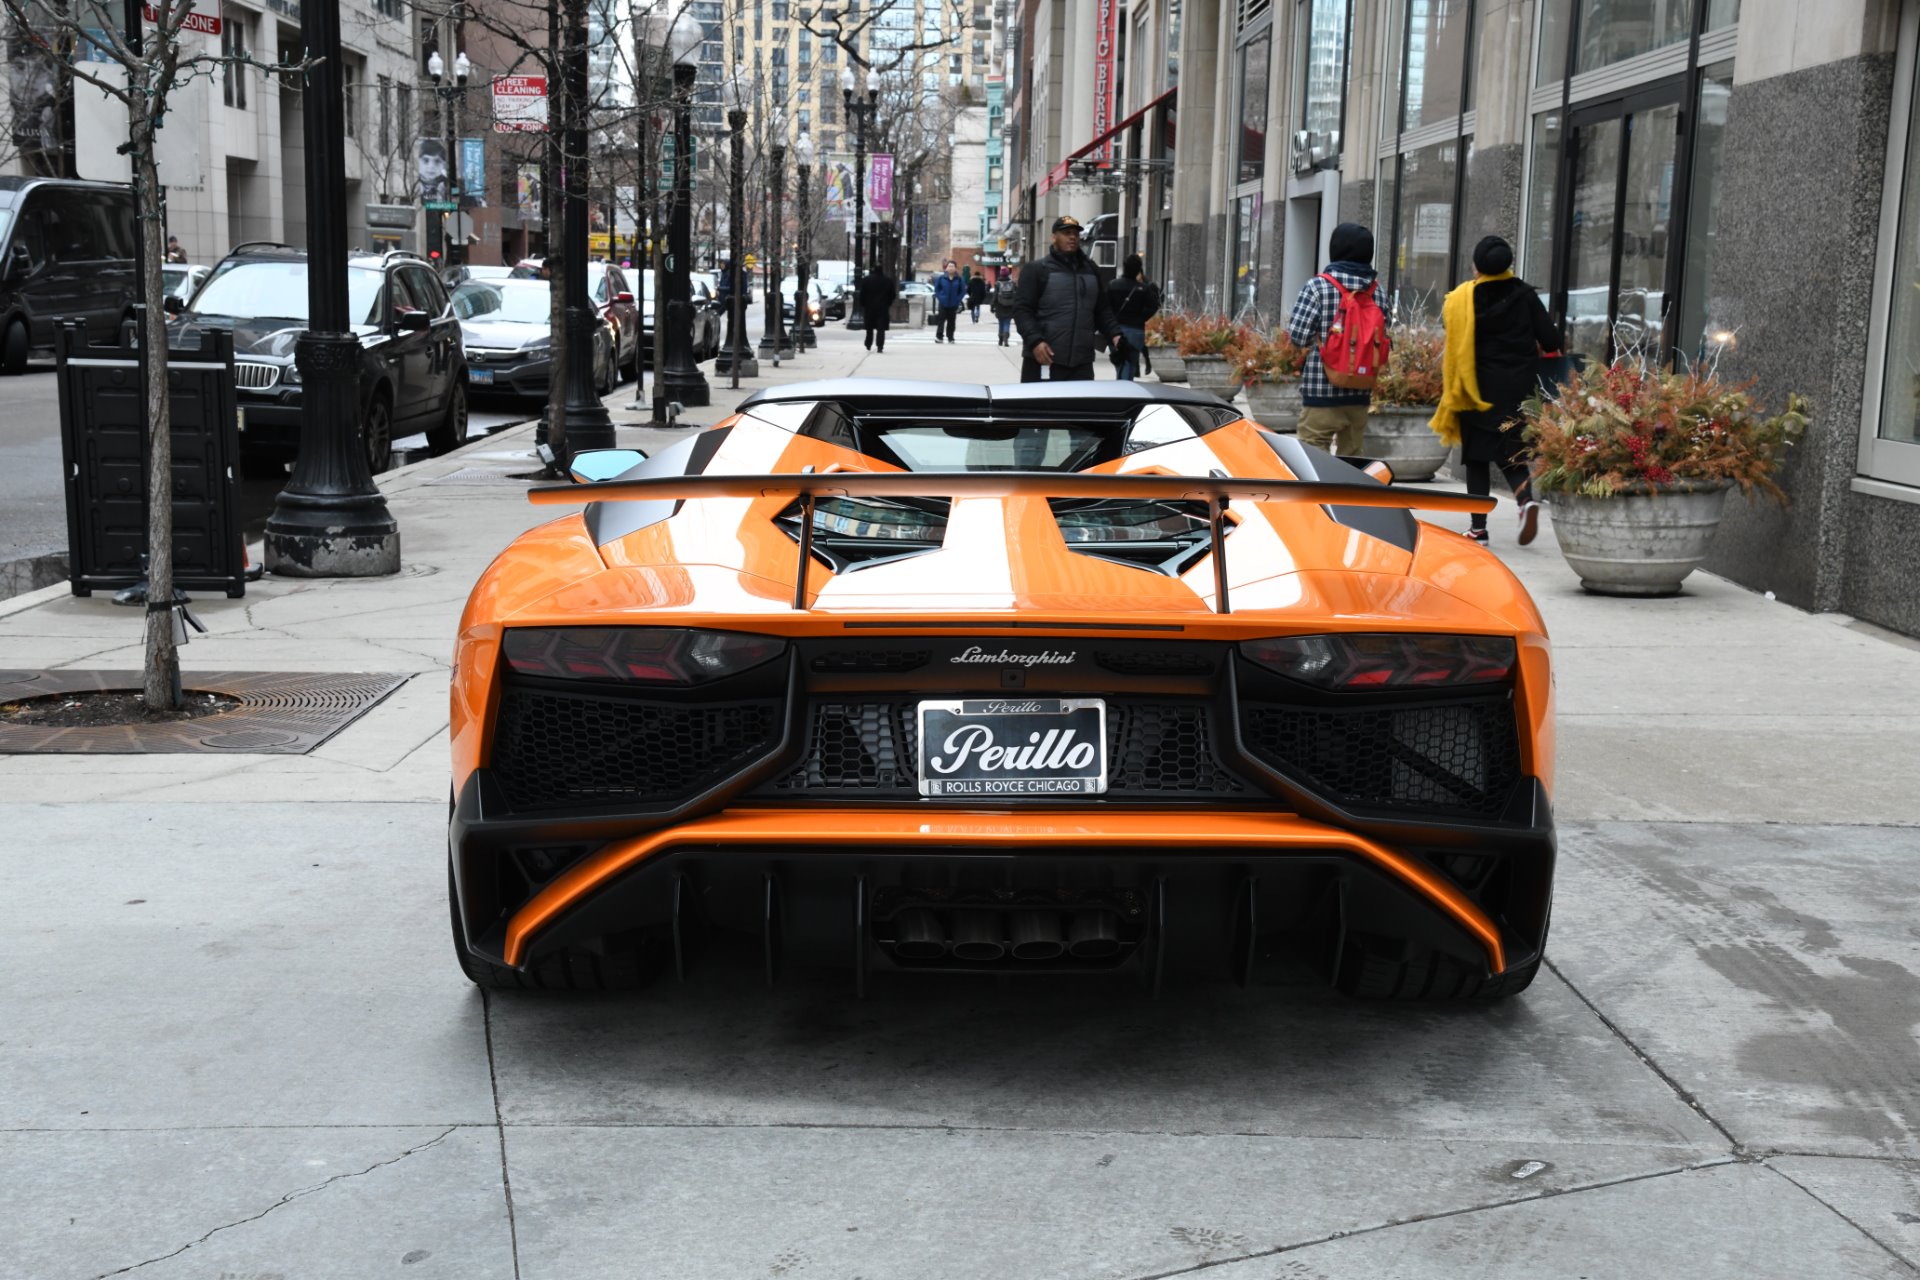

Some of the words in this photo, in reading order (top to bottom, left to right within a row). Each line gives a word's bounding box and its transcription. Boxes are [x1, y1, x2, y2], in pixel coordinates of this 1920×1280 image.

[181, 13, 216, 33] ZONE
[496, 78, 528, 86] STREET
[496, 86, 541, 94] CLEANING
[951, 646, 1077, 667] Lamborghini
[983, 701, 1042, 714] Perillo
[930, 724, 1095, 774] Perillo
[946, 781, 982, 793] ROLLS
[985, 782, 1024, 793] ROYCE
[1027, 780, 1080, 792] CHICAGO
